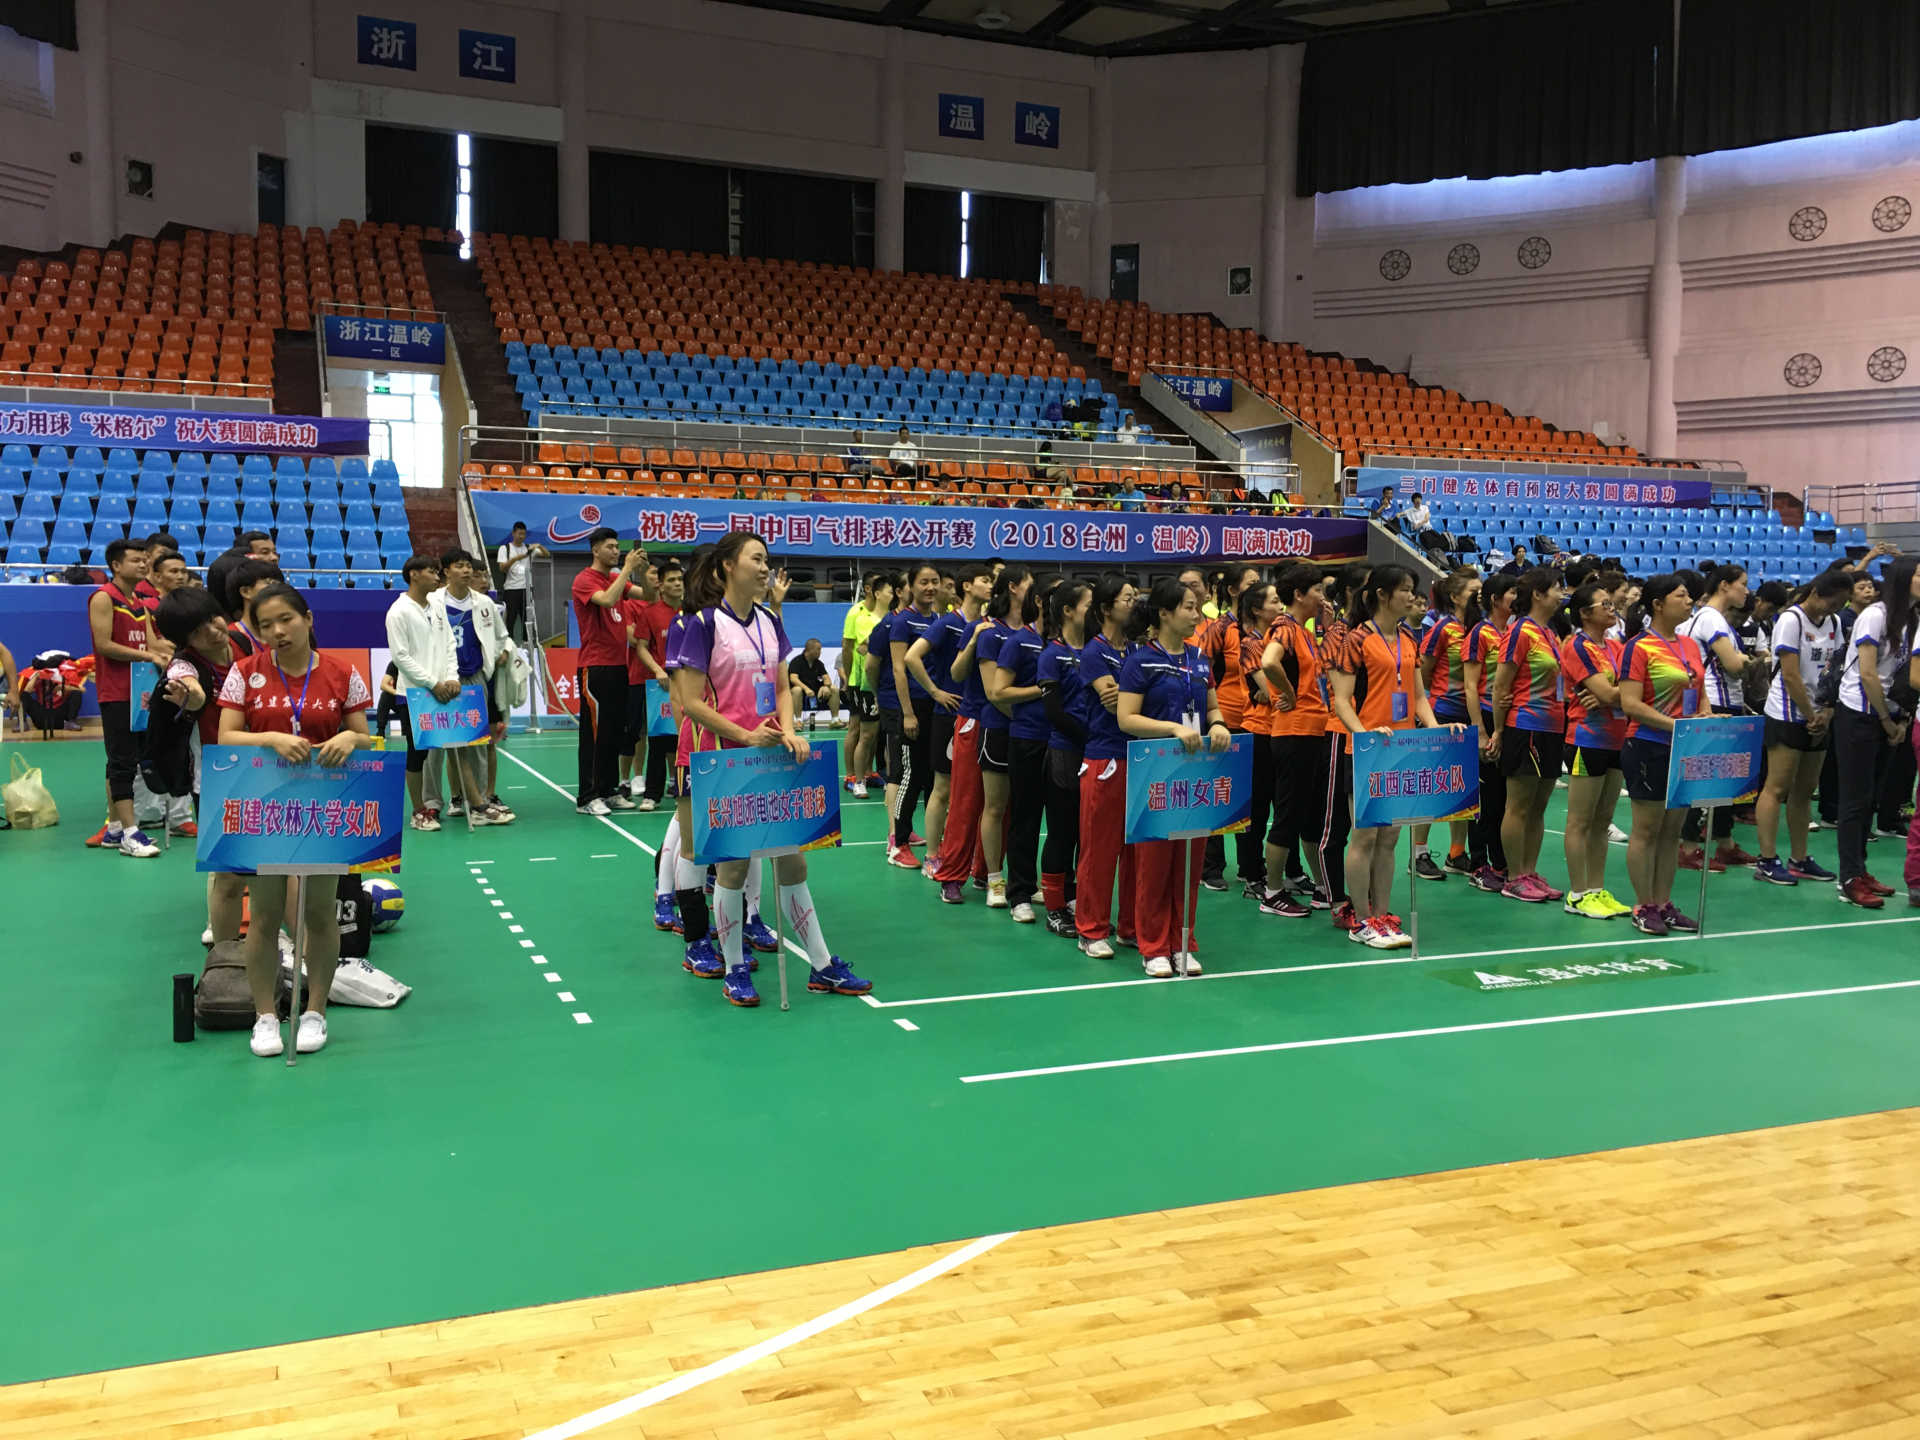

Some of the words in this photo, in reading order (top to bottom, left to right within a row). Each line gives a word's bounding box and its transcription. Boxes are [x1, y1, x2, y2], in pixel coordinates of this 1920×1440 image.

[371, 27, 406, 61] 浙
[472, 40, 505, 72] 江
[949, 103, 976, 132] 温
[1024, 110, 1050, 140] 岭
[339, 319, 433, 346] 浙江温岭
[418, 708, 482, 731] 温州大学
[1147, 775, 1232, 812] 温州女青
[1368, 764, 1466, 798] 江西定南女队
[222, 797, 382, 838] 福建农林大学女队
